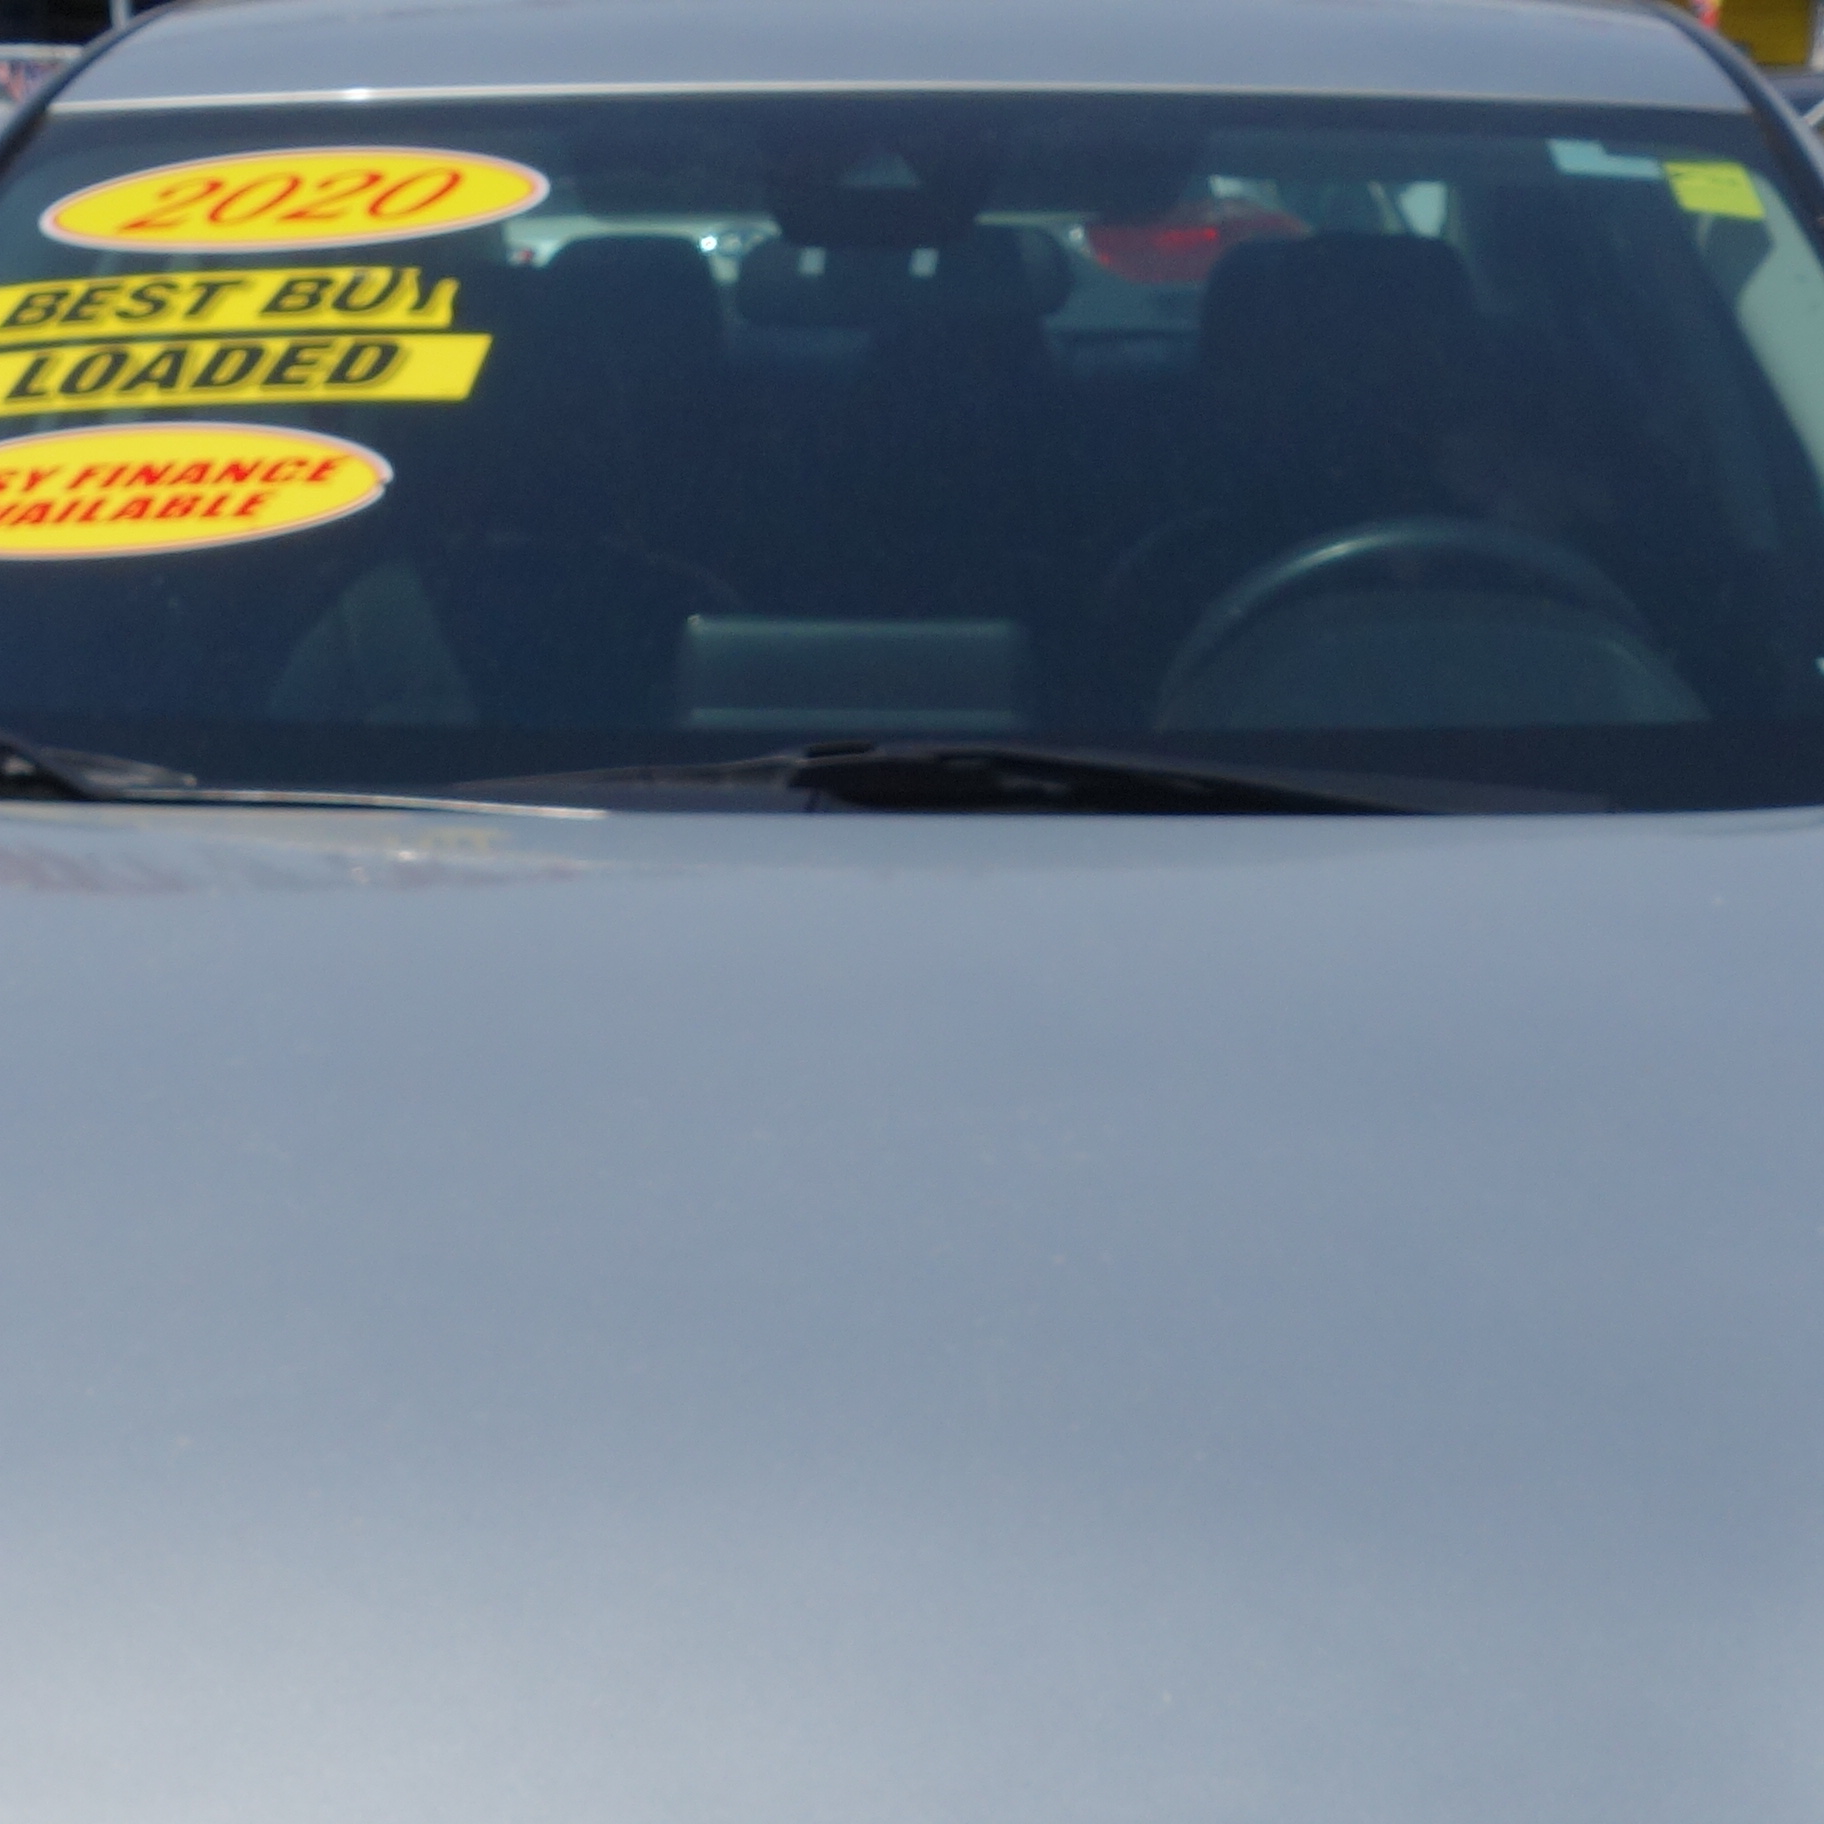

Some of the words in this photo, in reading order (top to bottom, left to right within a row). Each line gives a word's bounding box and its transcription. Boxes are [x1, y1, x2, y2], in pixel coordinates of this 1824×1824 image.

[116, 166, 463, 232] 2020
[5, 341, 402, 401] LOADED
[66, 455, 350, 490] FINANCE
